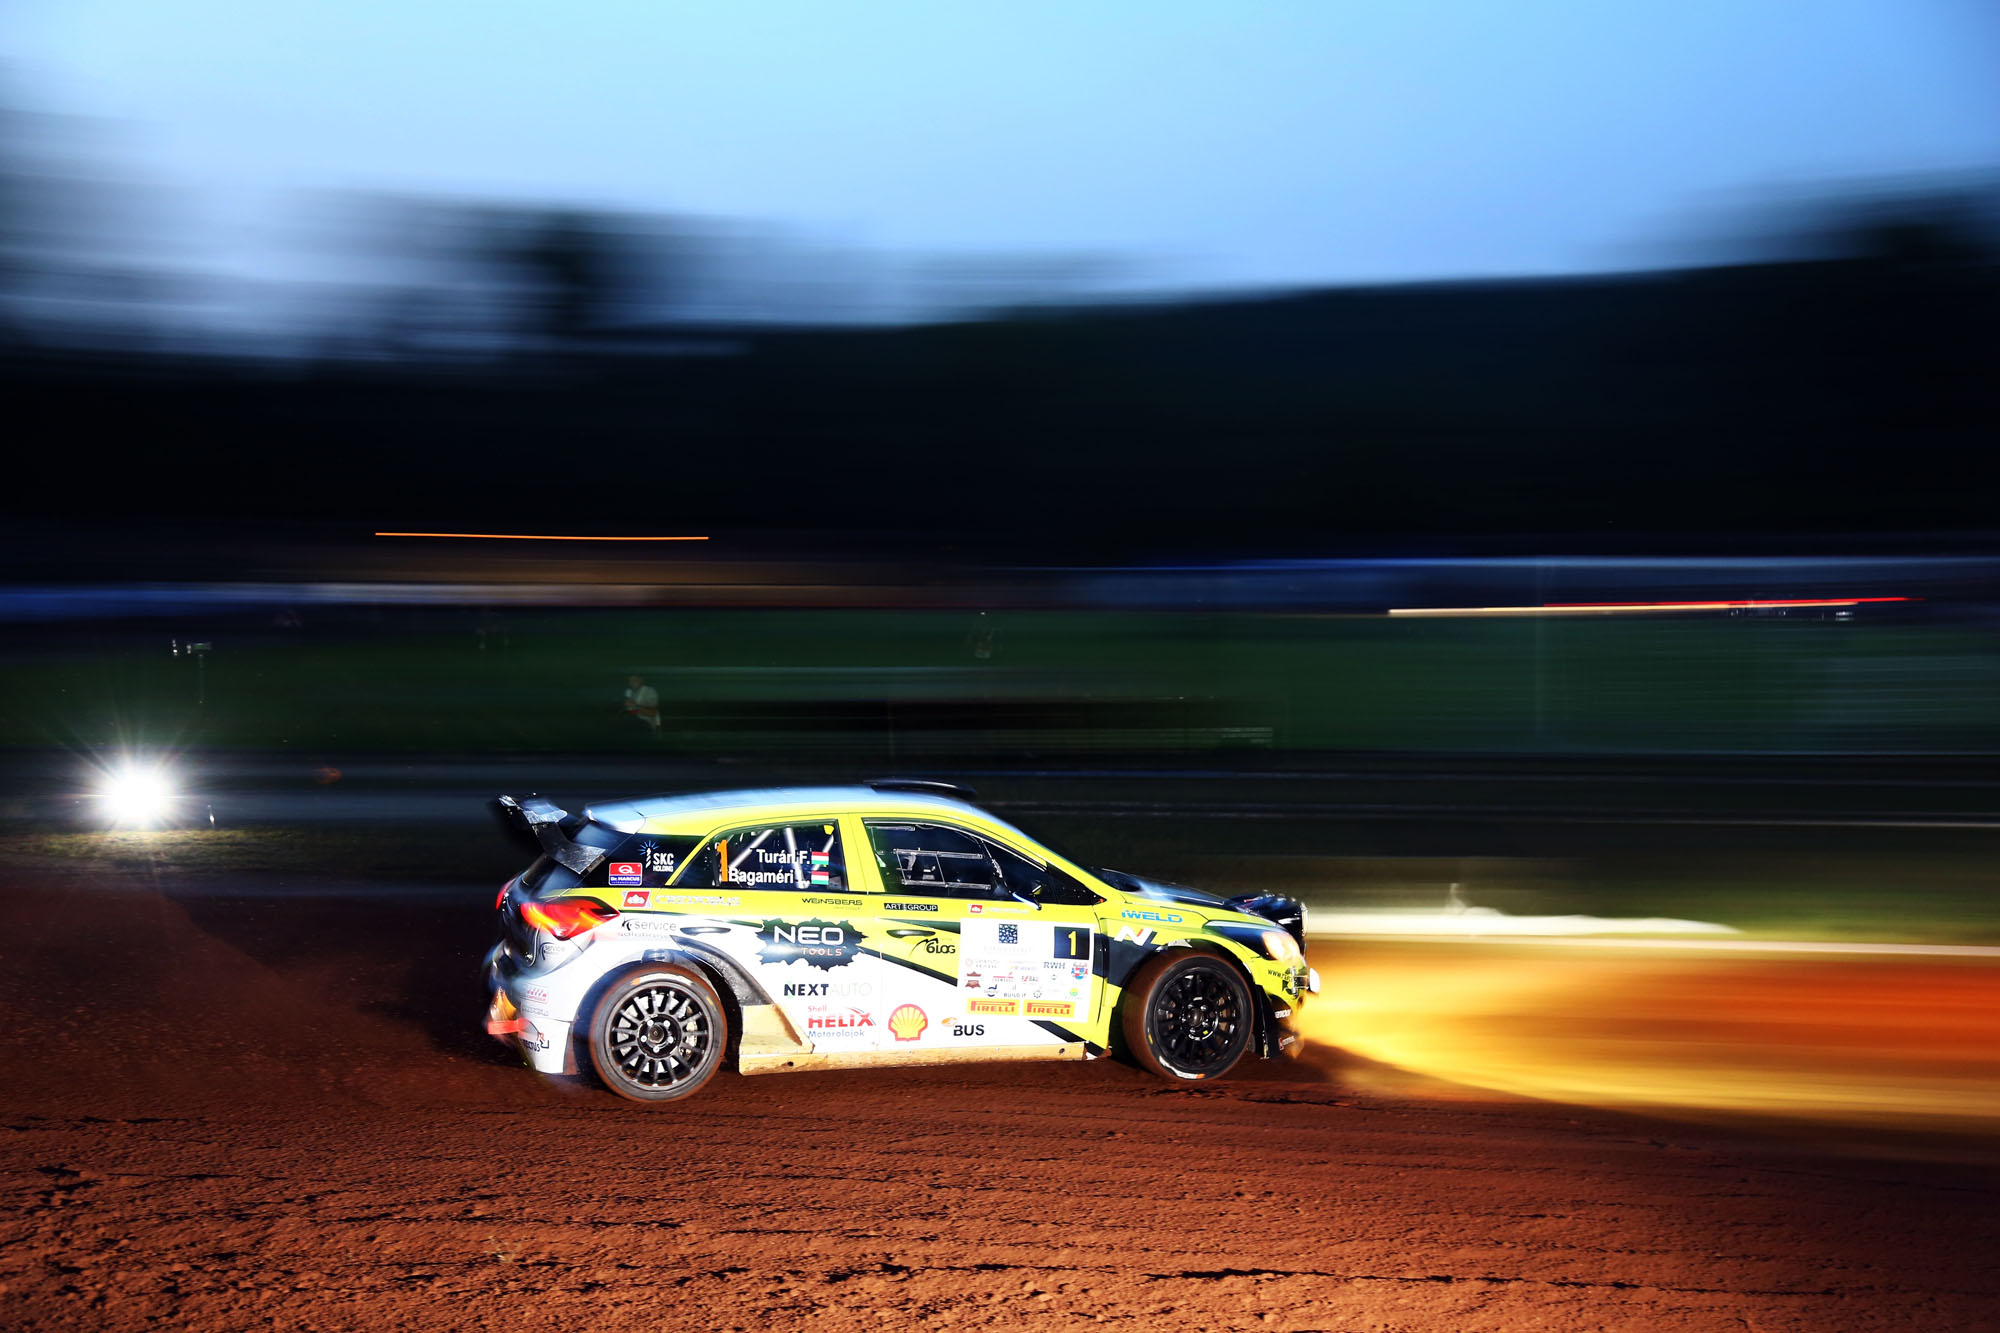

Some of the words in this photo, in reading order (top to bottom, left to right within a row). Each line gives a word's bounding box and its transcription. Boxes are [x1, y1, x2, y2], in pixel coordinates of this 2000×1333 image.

[653, 852, 674, 866] SKC
[716, 840, 729, 882] 1
[756, 849, 796, 865] Turán
[800, 850, 811, 865] F.
[728, 866, 794, 886] Bagaméri
[802, 897, 863, 906] WEINSBERG
[906, 904, 938, 912] GROUP
[634, 920, 677, 931] service
[774, 925, 844, 945] NEO
[1067, 931, 1078, 956] 1
[801, 947, 843, 956] TOOLS
[970, 1001, 1016, 1013] PIRELLI
[1026, 1002, 1072, 1015] PIRELLI
[953, 1024, 985, 1037] BUS
